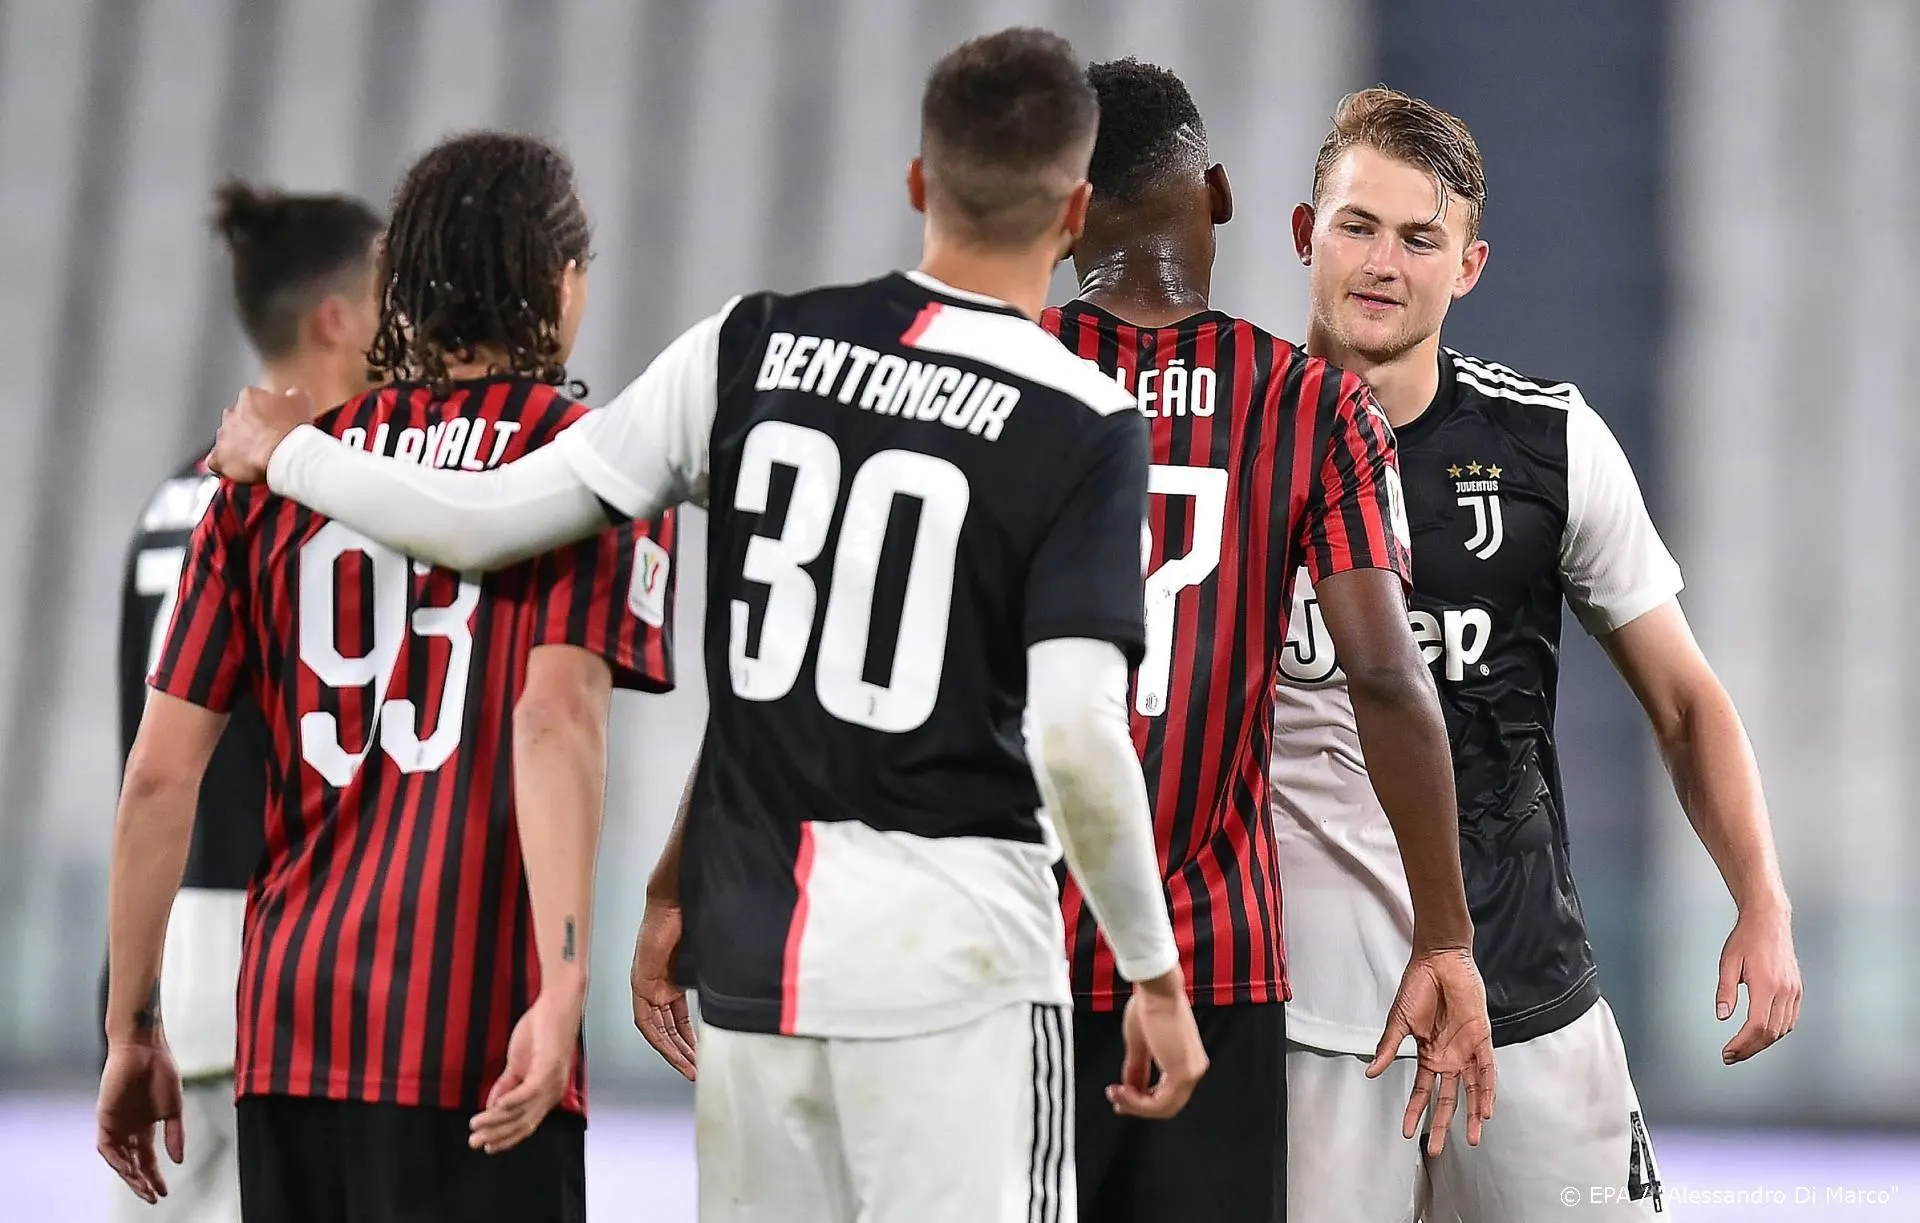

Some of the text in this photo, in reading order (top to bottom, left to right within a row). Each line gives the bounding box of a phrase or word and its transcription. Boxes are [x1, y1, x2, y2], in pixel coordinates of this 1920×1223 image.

[756, 332, 1021, 442] BENTANCUR
[1455, 480, 1499, 493] JUVENTUS
[729, 420, 970, 734] 30
[299, 520, 482, 788] 93
[1279, 599, 1492, 683] Jep
